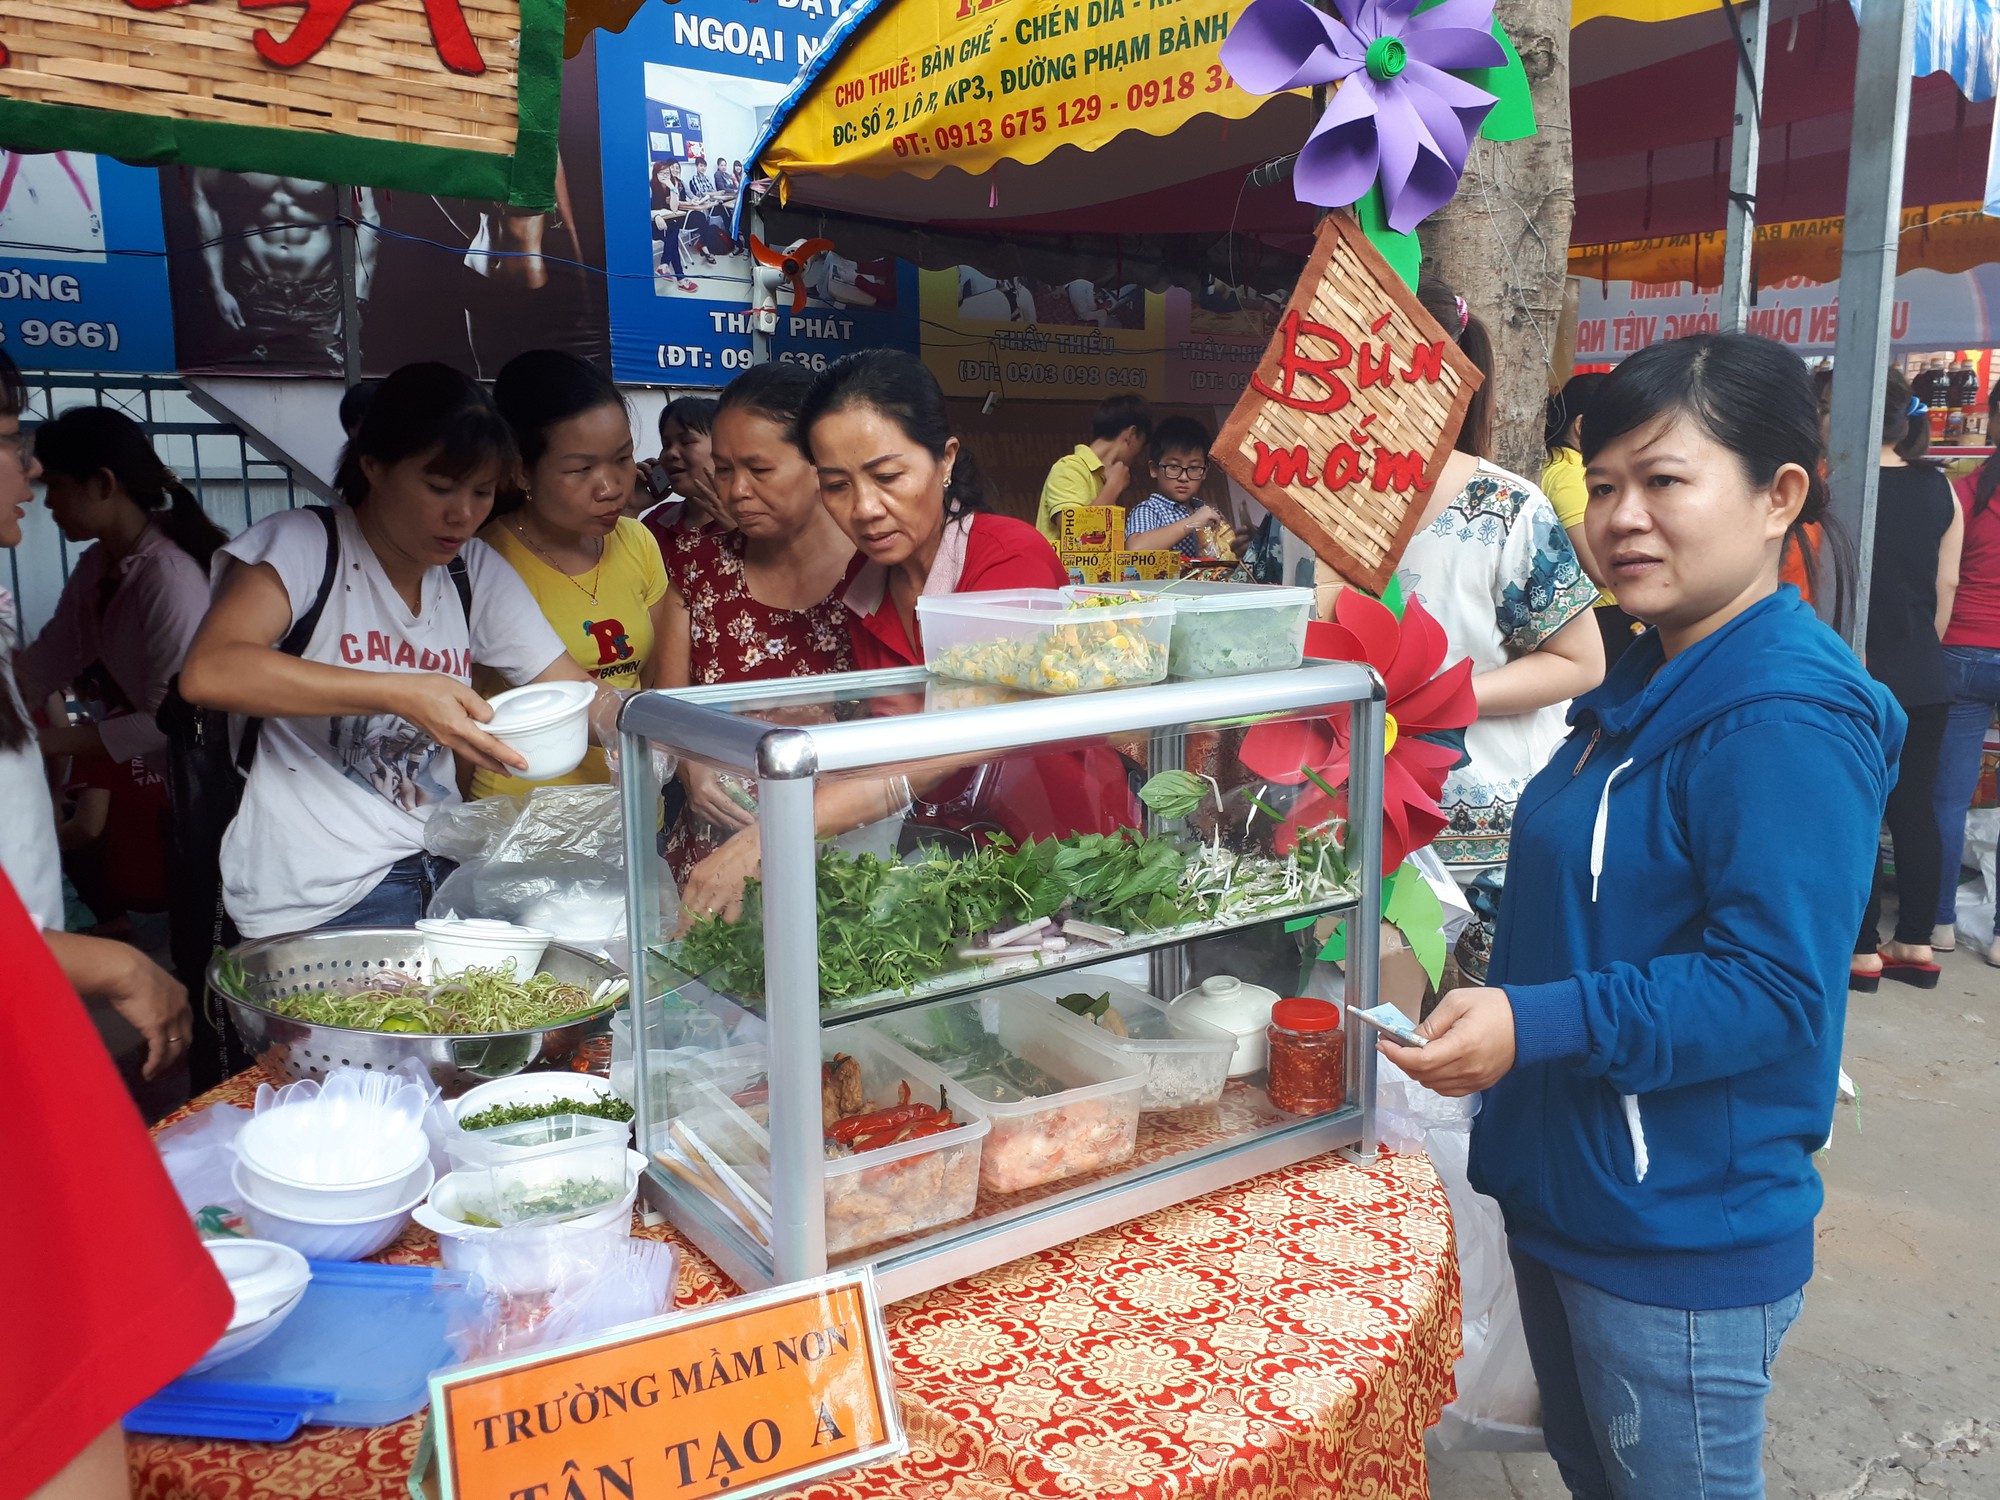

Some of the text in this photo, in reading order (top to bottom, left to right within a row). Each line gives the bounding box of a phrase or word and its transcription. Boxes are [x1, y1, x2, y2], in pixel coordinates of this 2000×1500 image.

[778, 0, 842, 20] ẠY
[673, 11, 785, 65] NGOẠI
[835, 78, 865, 108] CHO
[869, 56, 916, 96] THUÊ:
[921, 44, 955, 79] BÀN
[959, 18, 998, 63] GHẾ
[1015, 3, 1079, 45] CHÉN
[833, 121, 857, 147] ĐC:
[861, 103, 882, 138] SỐ
[885, 107, 899, 132] 2,
[902, 92, 923, 123] LÔ
[944, 74, 994, 106] KP3,
[1000, 56, 1077, 95] ĐƯỜNG
[1084, 33, 1150, 76] PHẠM
[1158, 11, 1229, 56] BÀNH
[892, 132, 931, 157] ĐT:
[934, 118, 993, 151] 0913
[1000, 106, 1047, 139] 675
[1057, 94, 1101, 128] 129
[1127, 71, 1195, 112] 0918
[20, 319, 119, 352] 966)
[710, 311, 854, 340] TH PHÁT
[994, 324, 1051, 353] THẦY
[657, 345, 713, 369] (ĐT:
[721, 348, 769, 370] 09
[1179, 336, 1226, 361] THẦY
[1251, 309, 1446, 415] Bún
[958, 360, 1147, 388] (ĐT: 0903 098 646)
[1251, 413, 1434, 493] mắm
[600, 660, 641, 680] BROWN
[474, 1321, 851, 1452] TRƯỜNG MẦM NON
[665, 1418, 783, 1489] TẠO
[810, 1401, 846, 1448] A
